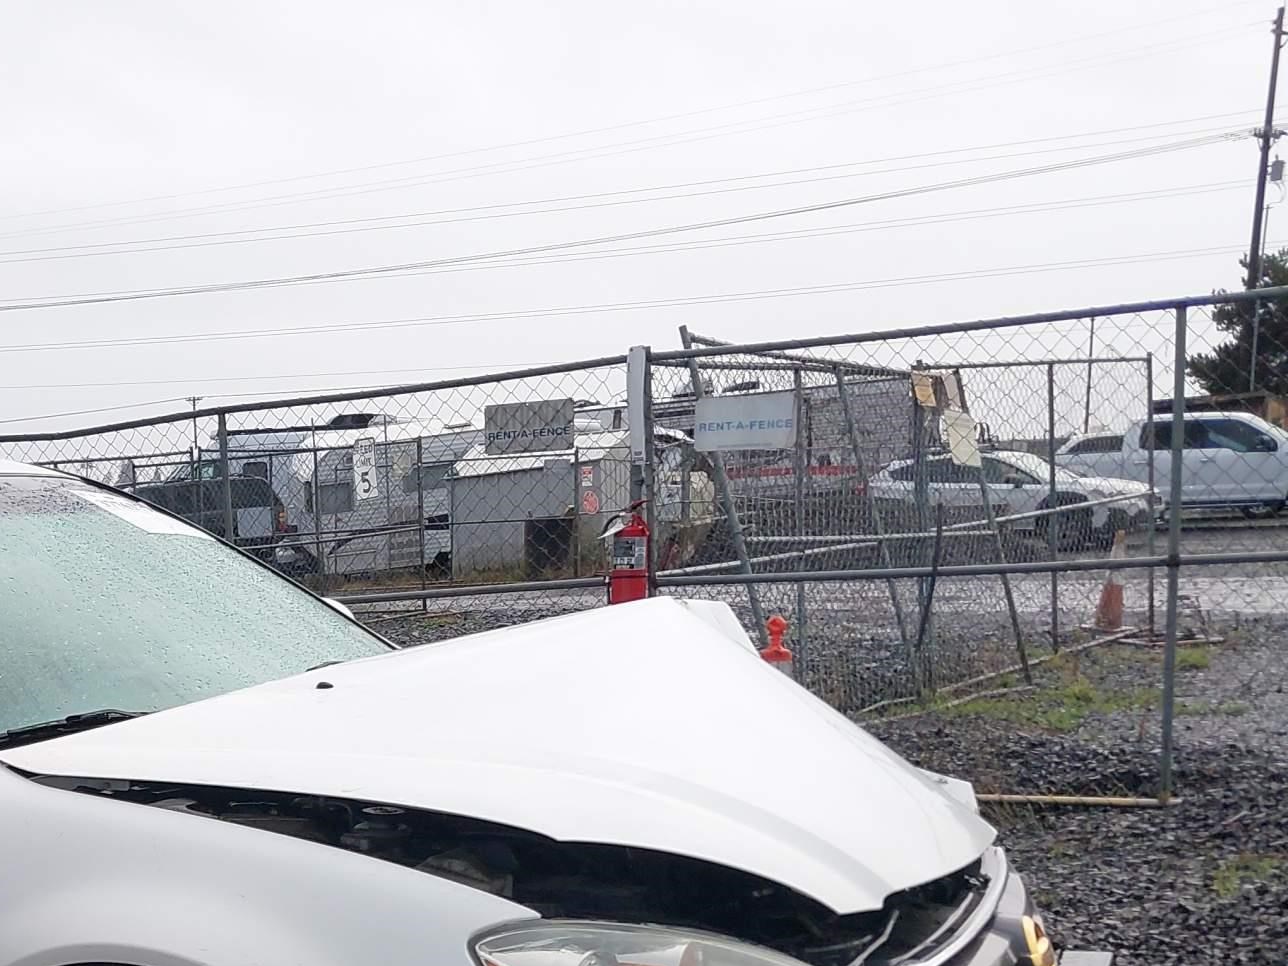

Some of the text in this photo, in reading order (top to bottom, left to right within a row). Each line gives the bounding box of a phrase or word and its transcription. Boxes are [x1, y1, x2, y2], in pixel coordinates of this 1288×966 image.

[699, 418, 793, 433] RENT-A-FENCE
[488, 426, 570, 441] RENT-A-FENCE
[361, 471, 371, 493] 5
